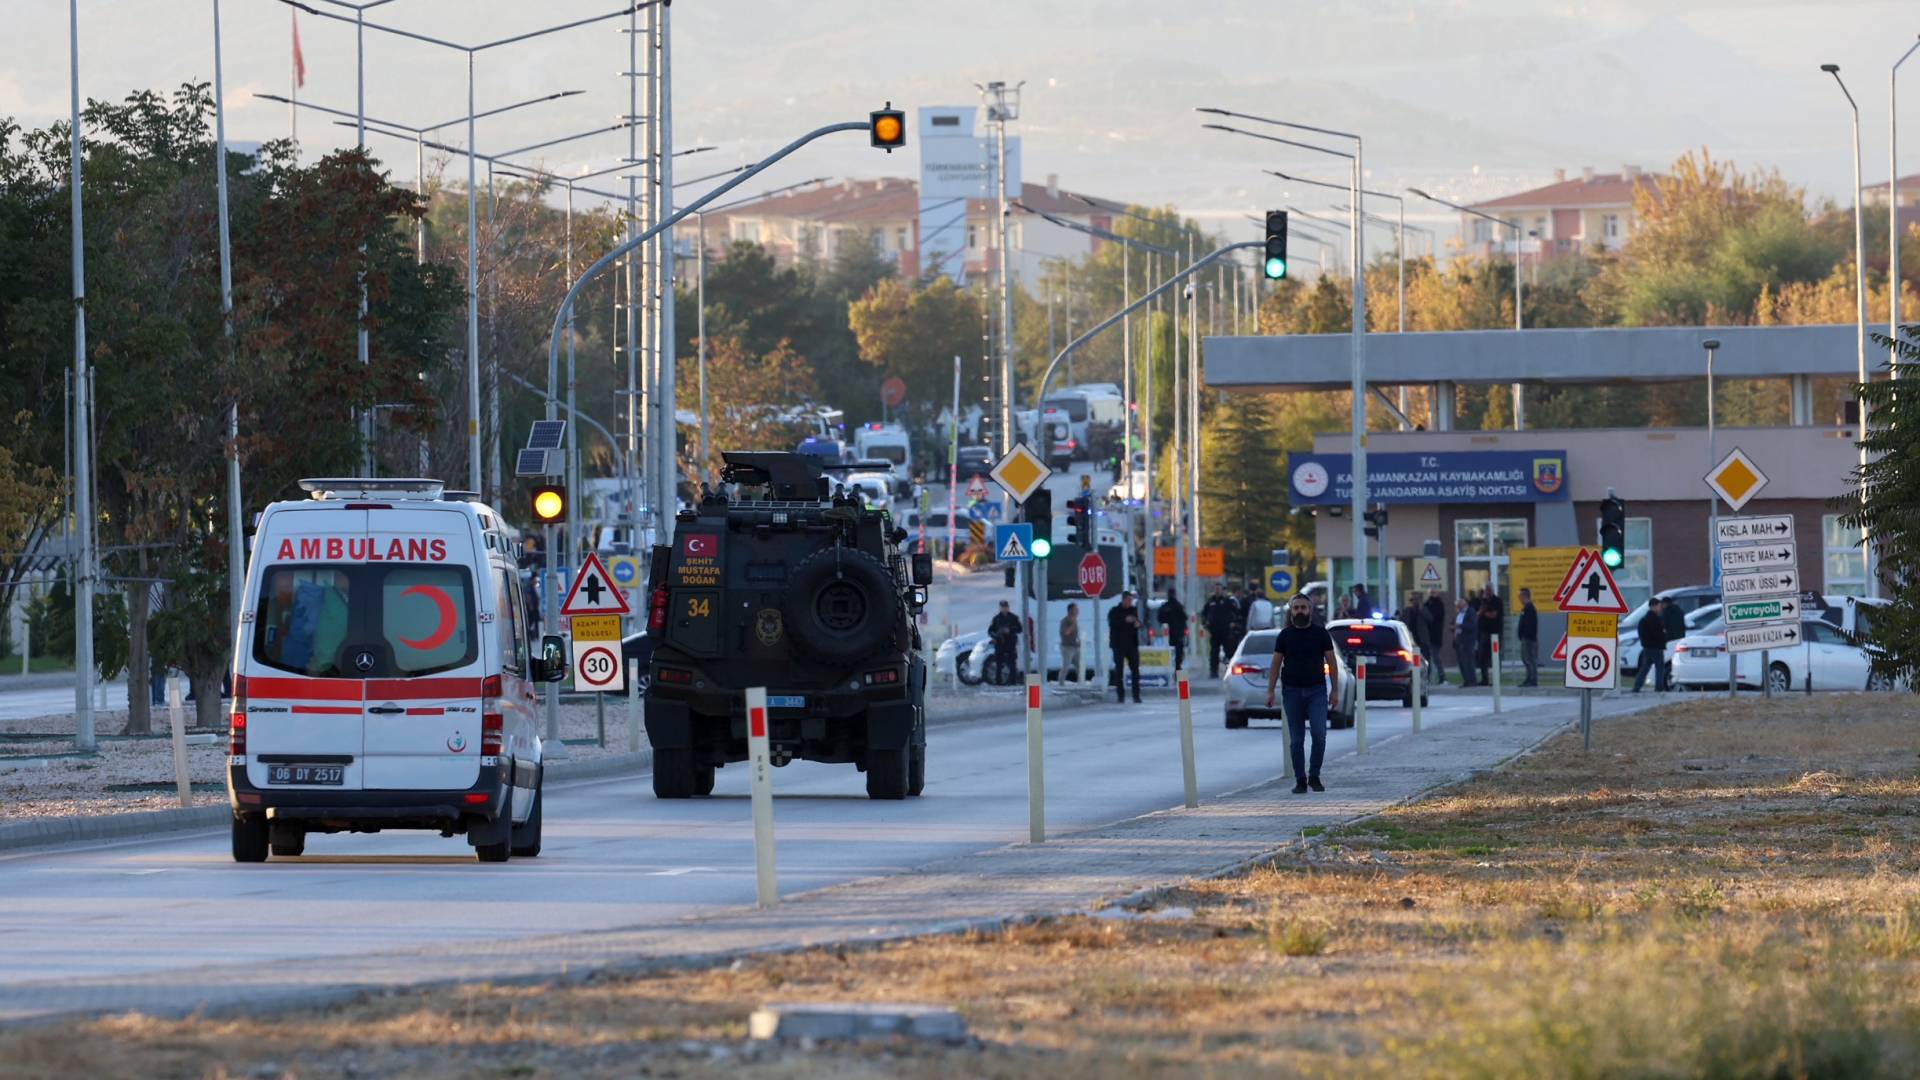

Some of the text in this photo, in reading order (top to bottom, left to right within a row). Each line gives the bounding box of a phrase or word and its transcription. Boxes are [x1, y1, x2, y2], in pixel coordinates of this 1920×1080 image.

[1421, 456, 1439, 467] T.C.
[1336, 469, 1524, 483] KAAMANKAZAN KAYMAKAMLIĞI
[1374, 486, 1435, 498] JANDARMA
[1438, 484, 1476, 498] ASAYİŞ
[1479, 485, 1527, 497] NOKTASI
[277, 538, 447, 561] AMBULANS
[677, 566, 721, 575] MUSTAFA
[1081, 566, 1104, 584] DUR
[682, 575, 716, 585] DOĞAN
[688, 599, 710, 617] 34
[1729, 603, 1779, 620] Çevreyolu
[588, 658, 608, 673] 30
[1580, 655, 1601, 670] 30
[276, 767, 341, 781] 06 DY 2517
